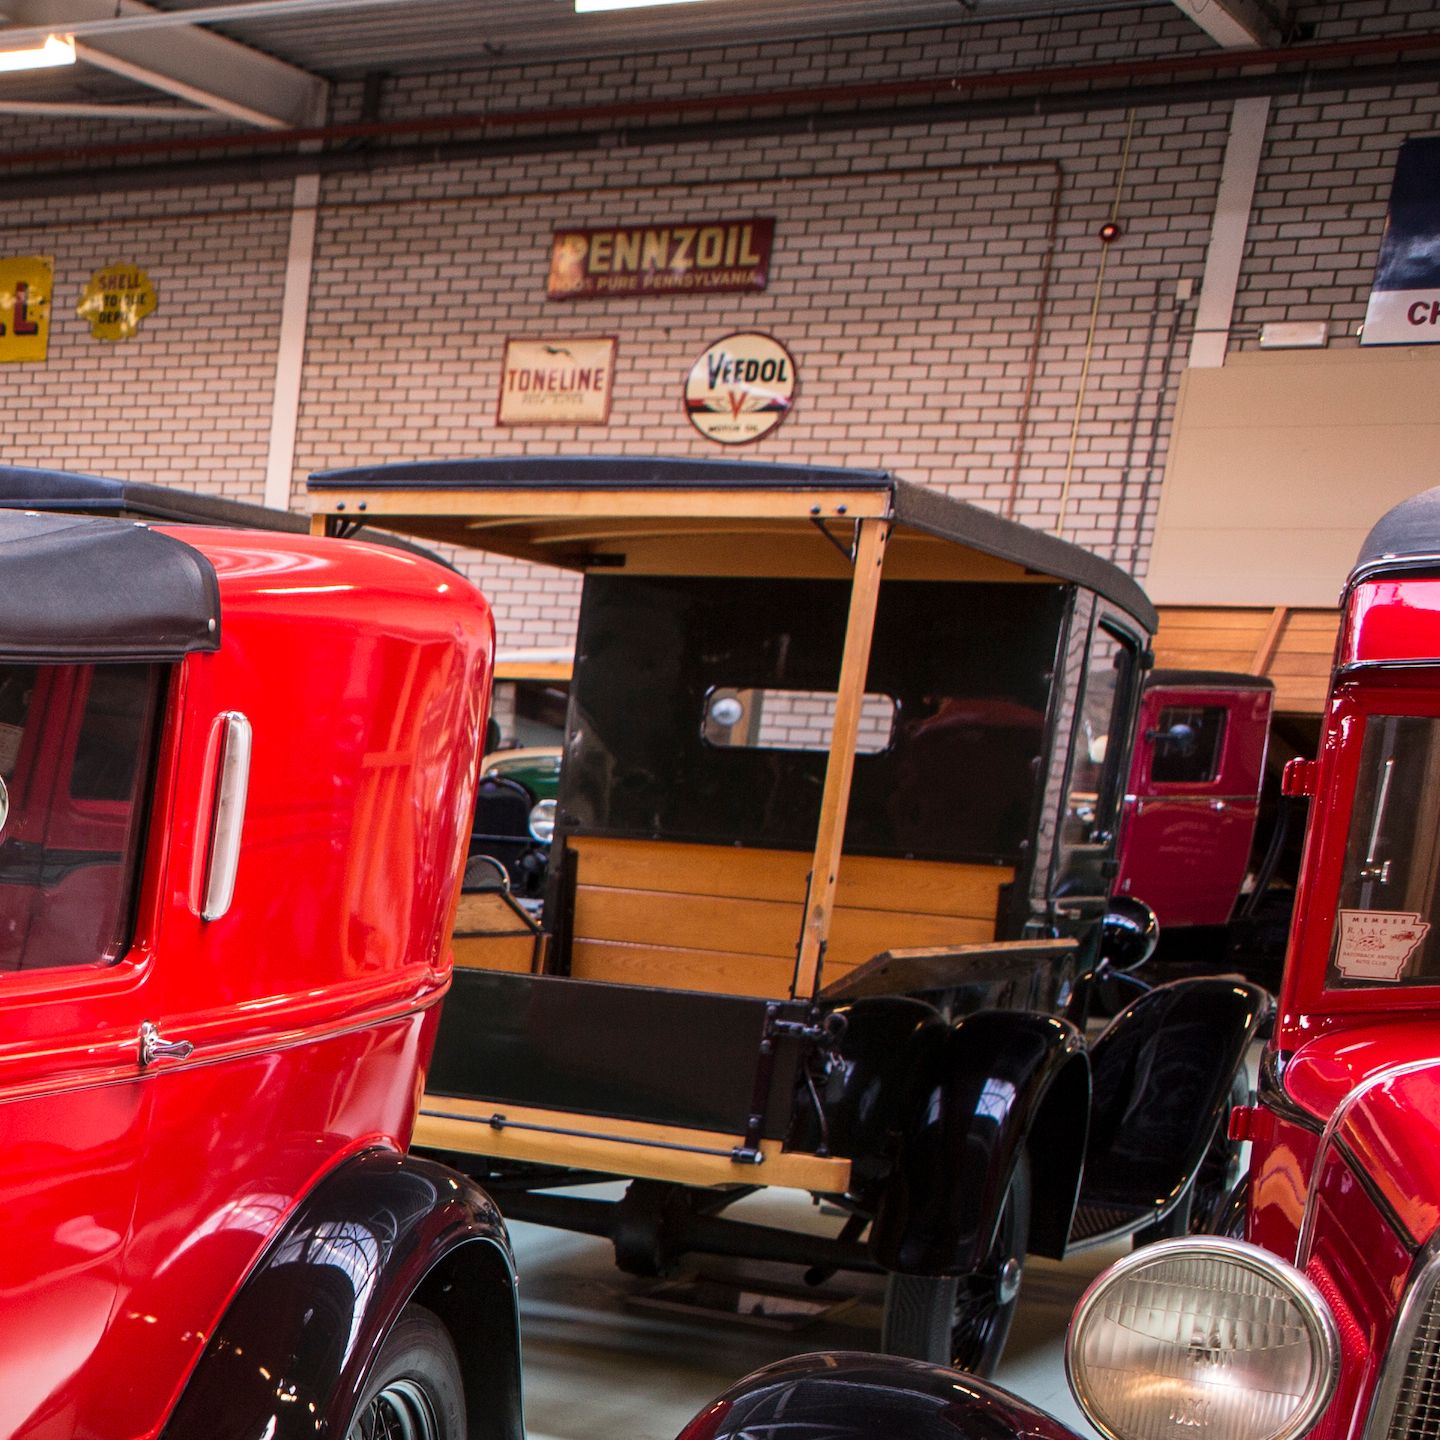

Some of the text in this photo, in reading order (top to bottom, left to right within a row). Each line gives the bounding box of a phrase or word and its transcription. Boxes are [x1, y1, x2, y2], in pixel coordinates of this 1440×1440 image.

[558, 225, 761, 274] PENNZOIL
[97, 273, 141, 290] SHELL
[597, 275, 638, 290] PURE
[509, 368, 605, 393] TONELINE
[708, 352, 787, 390] VEEDOL
